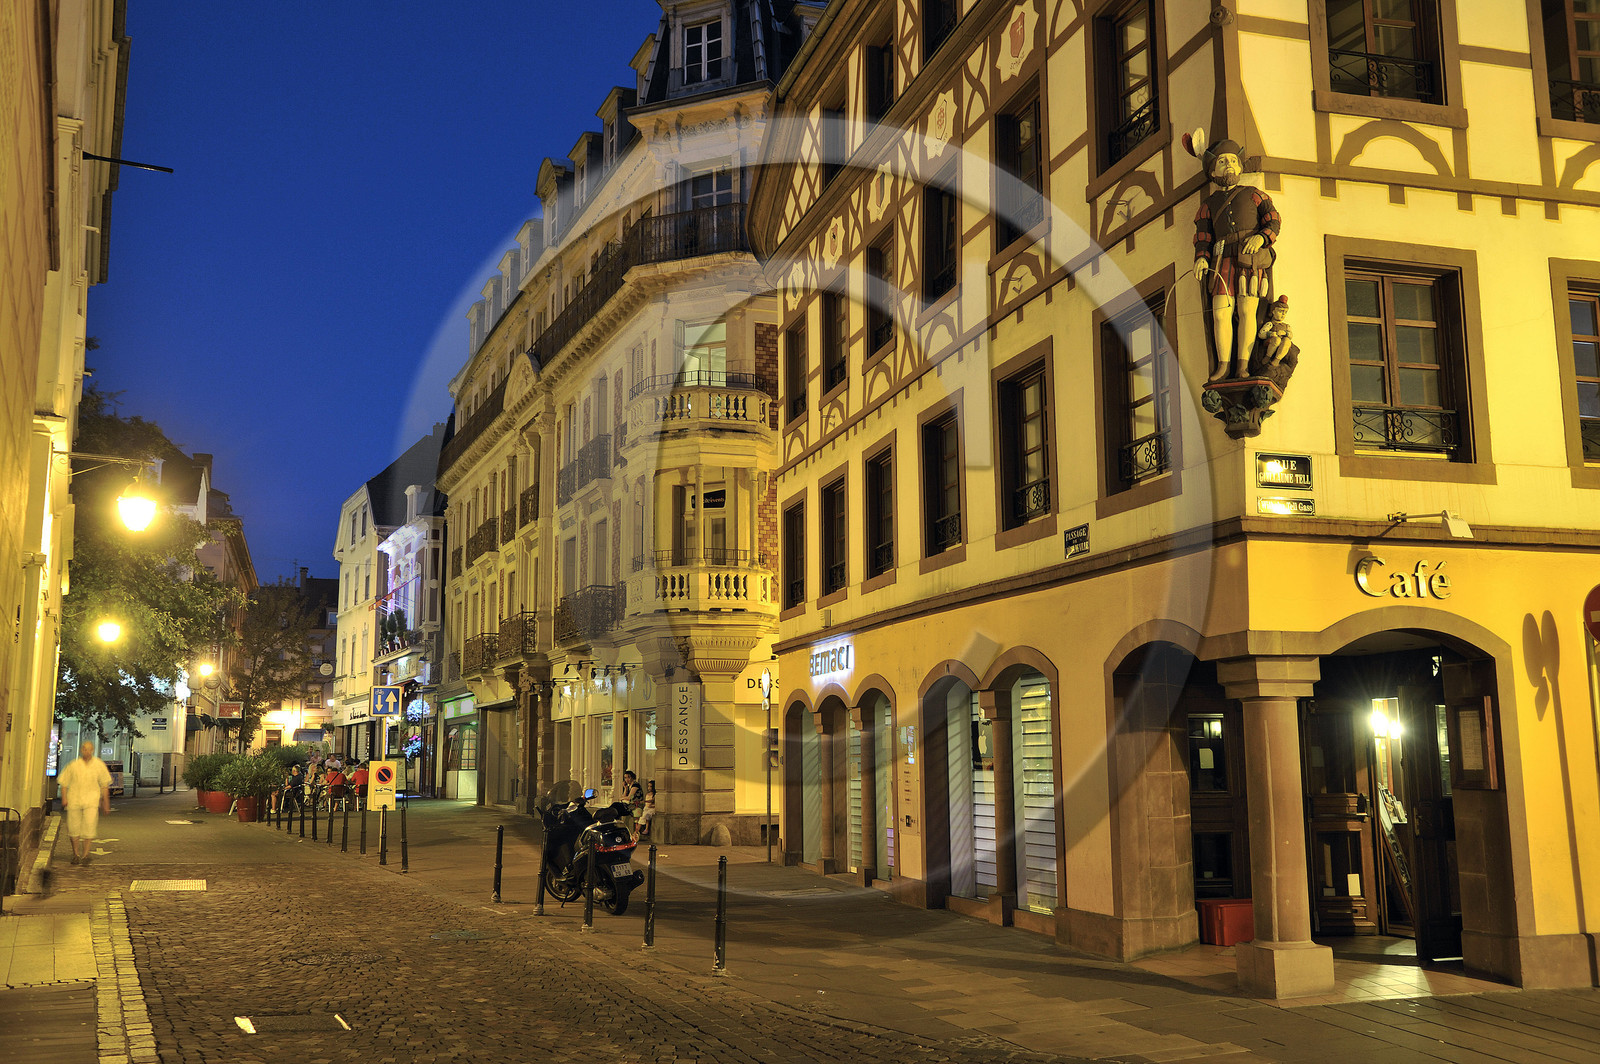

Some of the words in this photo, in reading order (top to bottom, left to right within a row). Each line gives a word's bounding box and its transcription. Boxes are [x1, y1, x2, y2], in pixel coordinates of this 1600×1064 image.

[1295, 474, 1310, 484] TELL
[1298, 502, 1313, 512] Gass
[1066, 528, 1087, 542] PASSAGE
[1354, 555, 1452, 600] Café
[678, 686, 688, 765] DESSANGE
